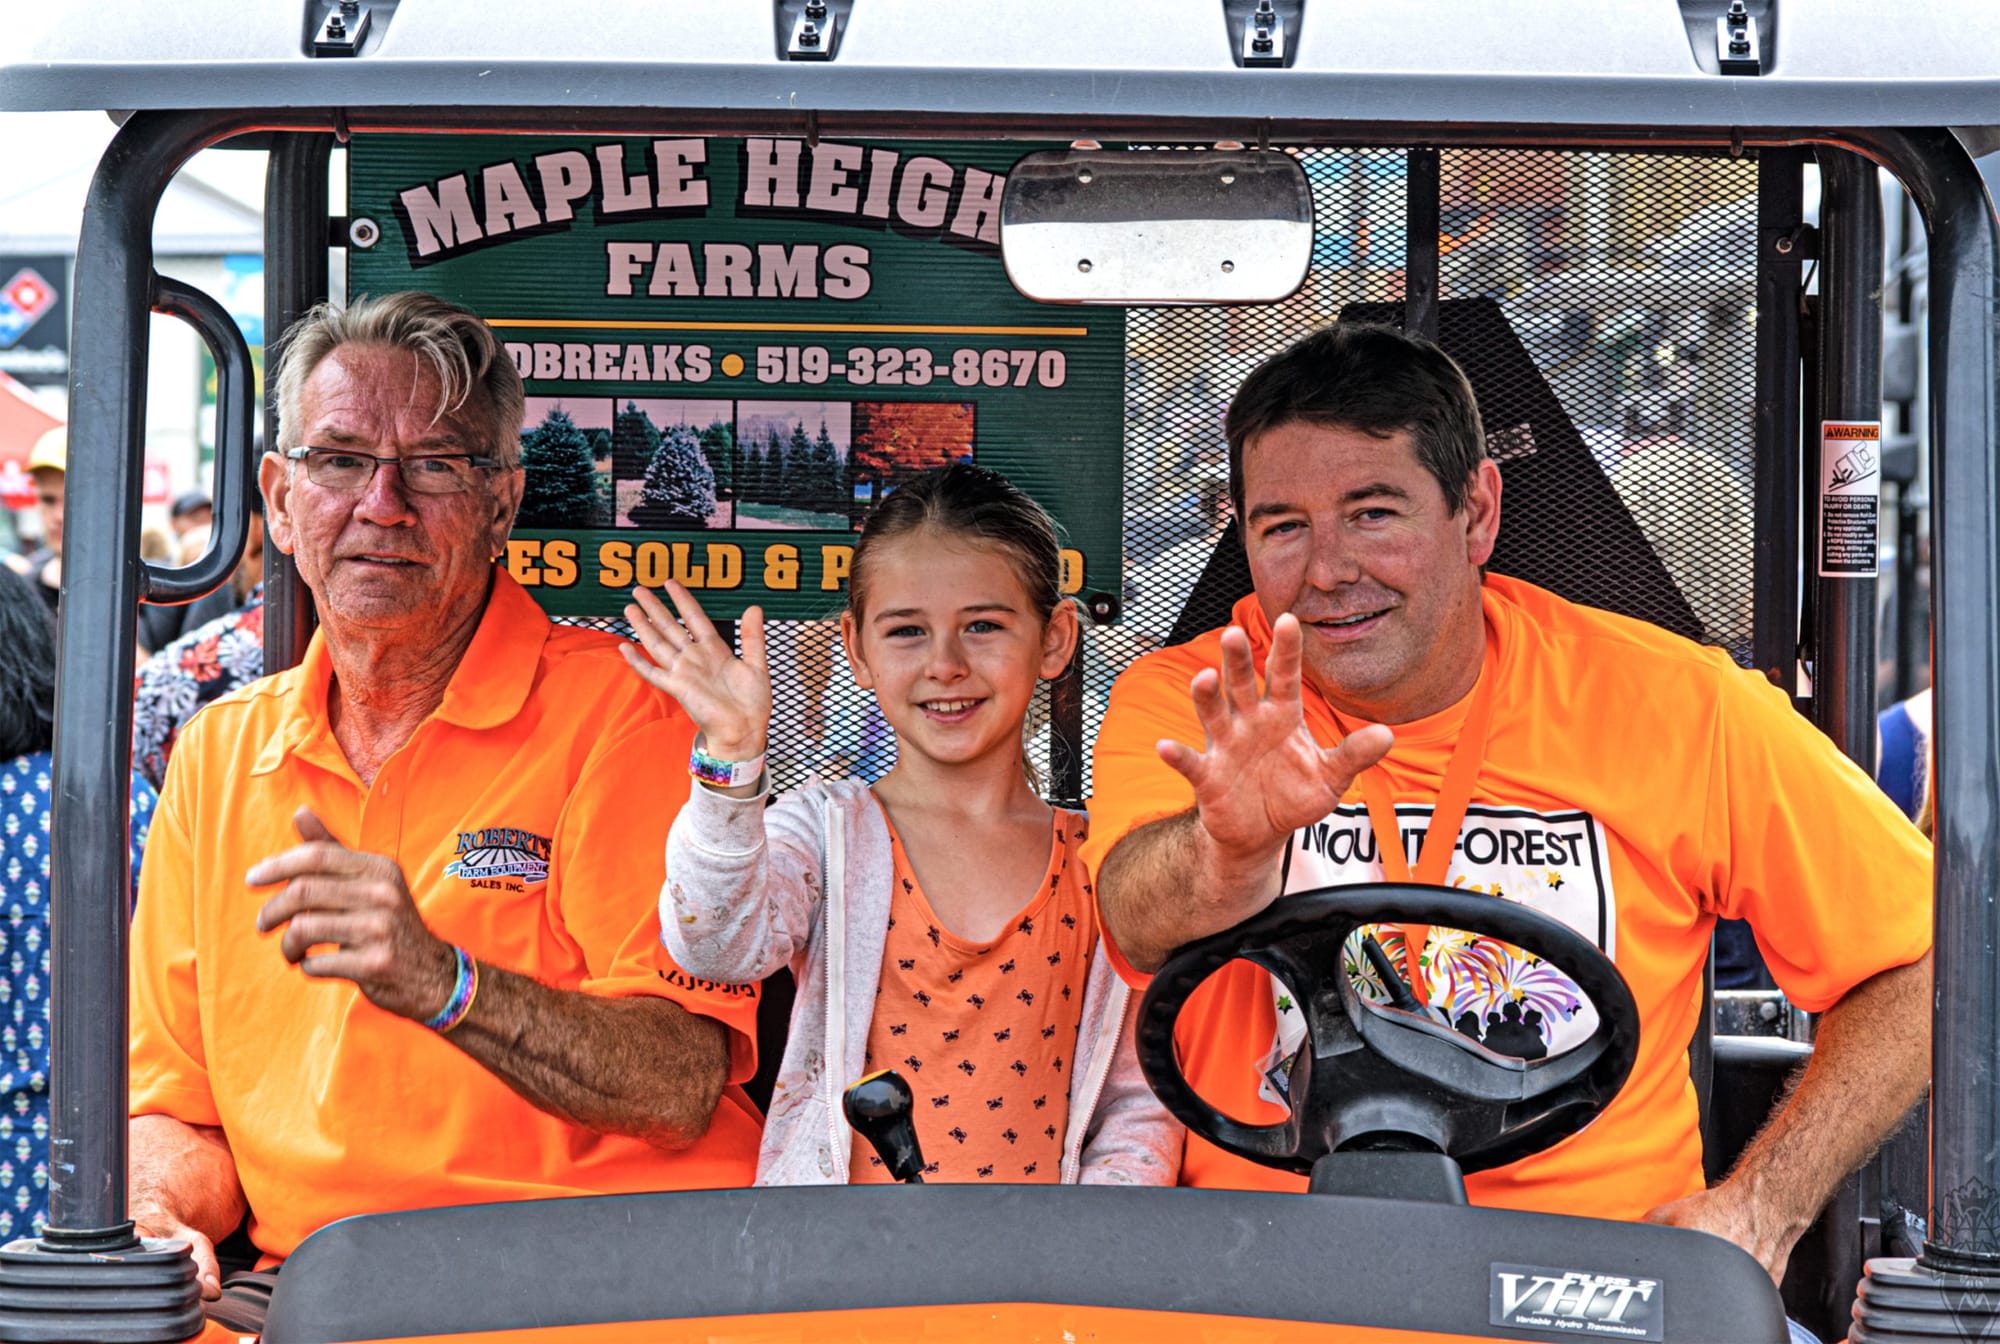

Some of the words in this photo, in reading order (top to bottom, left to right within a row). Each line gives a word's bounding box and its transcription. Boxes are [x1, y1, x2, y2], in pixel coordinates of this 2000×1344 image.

[400, 138, 709, 257] MAPLE
[606, 242, 872, 298] FARMS
[756, 346, 1067, 388] 519-323-8670
[1834, 427, 1879, 438] WARNING
[599, 541, 742, 588] SOLD
[763, 544, 800, 590] &
[461, 867, 488, 878] FARM
[490, 862, 545, 875] EQUIPMENT
[470, 879, 502, 889] SALES
[1498, 1273, 1653, 1325] VHT
[1516, 1315, 1551, 1326] Variable
[1555, 1319, 1583, 1330] Hydro
[1587, 1322, 1647, 1336] Transmission
